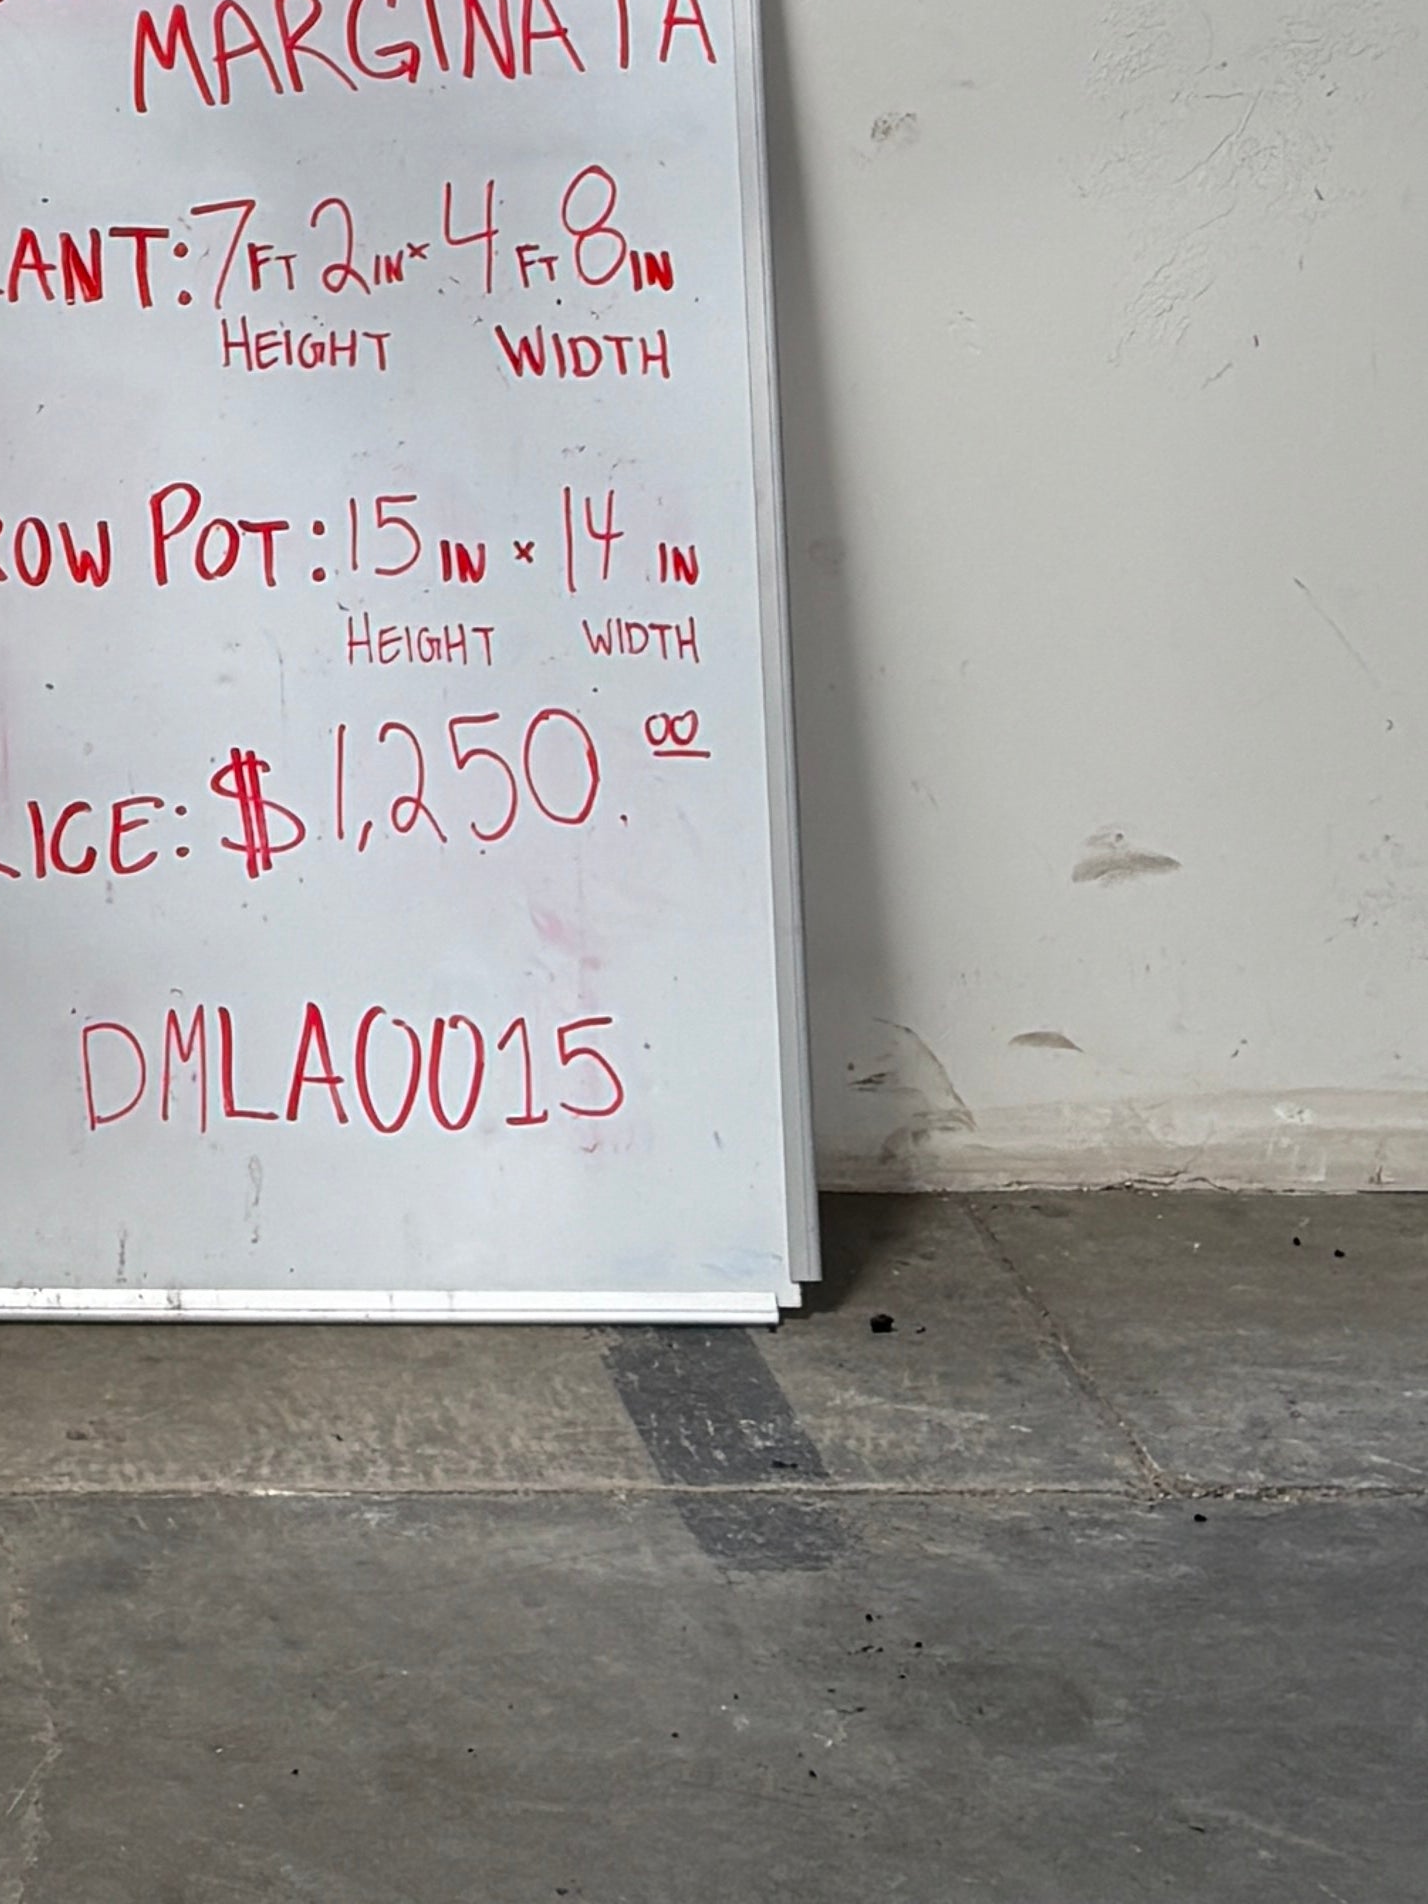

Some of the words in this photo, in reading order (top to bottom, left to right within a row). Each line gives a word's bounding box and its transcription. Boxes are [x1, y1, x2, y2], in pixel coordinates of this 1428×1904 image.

[221, 323, 392, 373] HEIGHT
[494, 327, 670, 380] WIDTH
[148, 481, 327, 588] POT:
[346, 612, 496, 667] HEIGHT
[582, 615, 702, 665] WIDTH
[81, 1001, 625, 1135] DMLA0015
